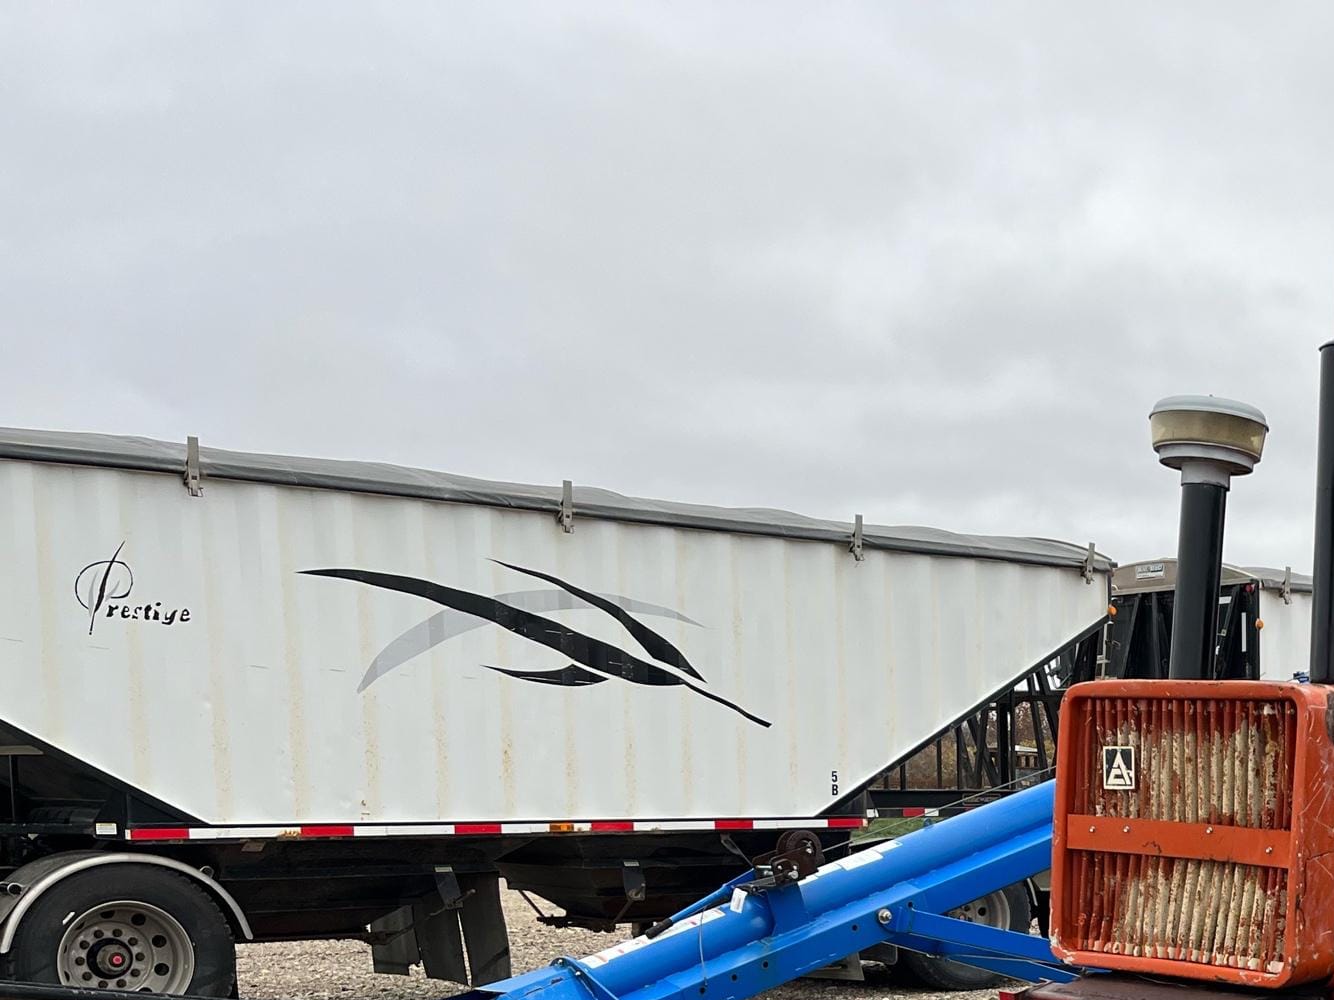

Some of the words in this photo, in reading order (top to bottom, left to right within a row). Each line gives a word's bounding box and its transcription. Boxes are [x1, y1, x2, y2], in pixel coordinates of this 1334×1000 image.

[75, 541, 191, 635] Prestige
[831, 770, 838, 783] 5
[831, 783, 839, 796] B
